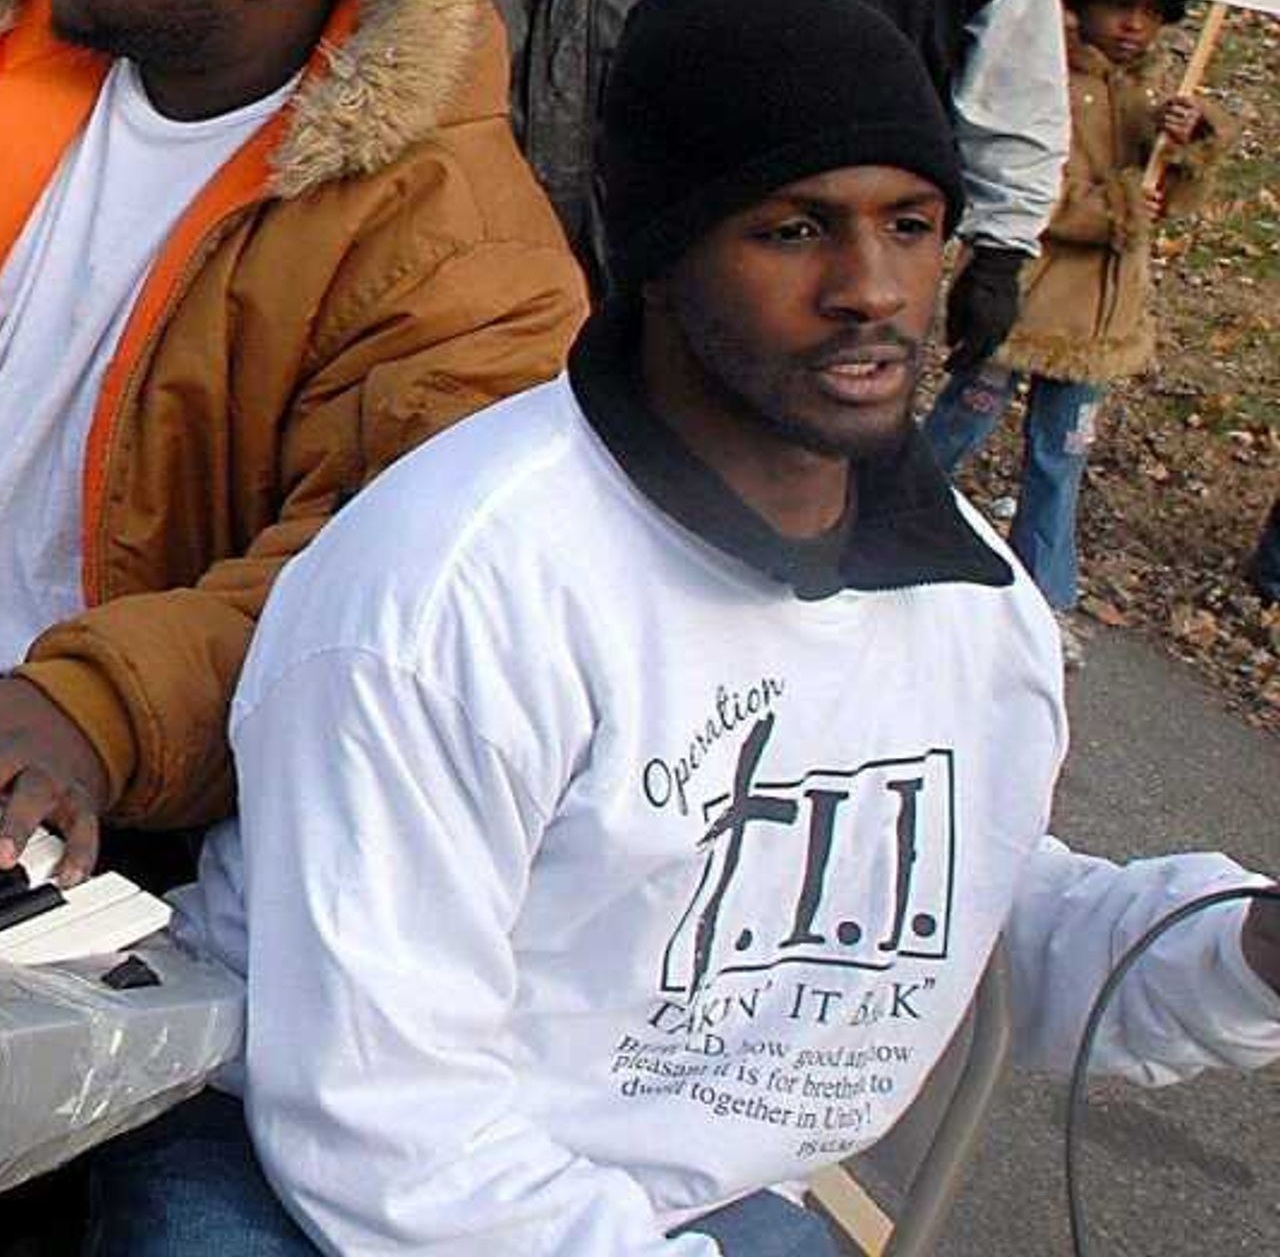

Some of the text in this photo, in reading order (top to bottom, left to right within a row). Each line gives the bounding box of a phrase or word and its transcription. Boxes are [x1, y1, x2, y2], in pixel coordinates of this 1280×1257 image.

[643, 678, 785, 816] Operation
[789, 982, 842, 1023] IT
[736, 1057, 760, 1085] is
[765, 1067, 799, 1094] for
[870, 1074, 893, 1093] to
[690, 1081, 795, 1128] together
